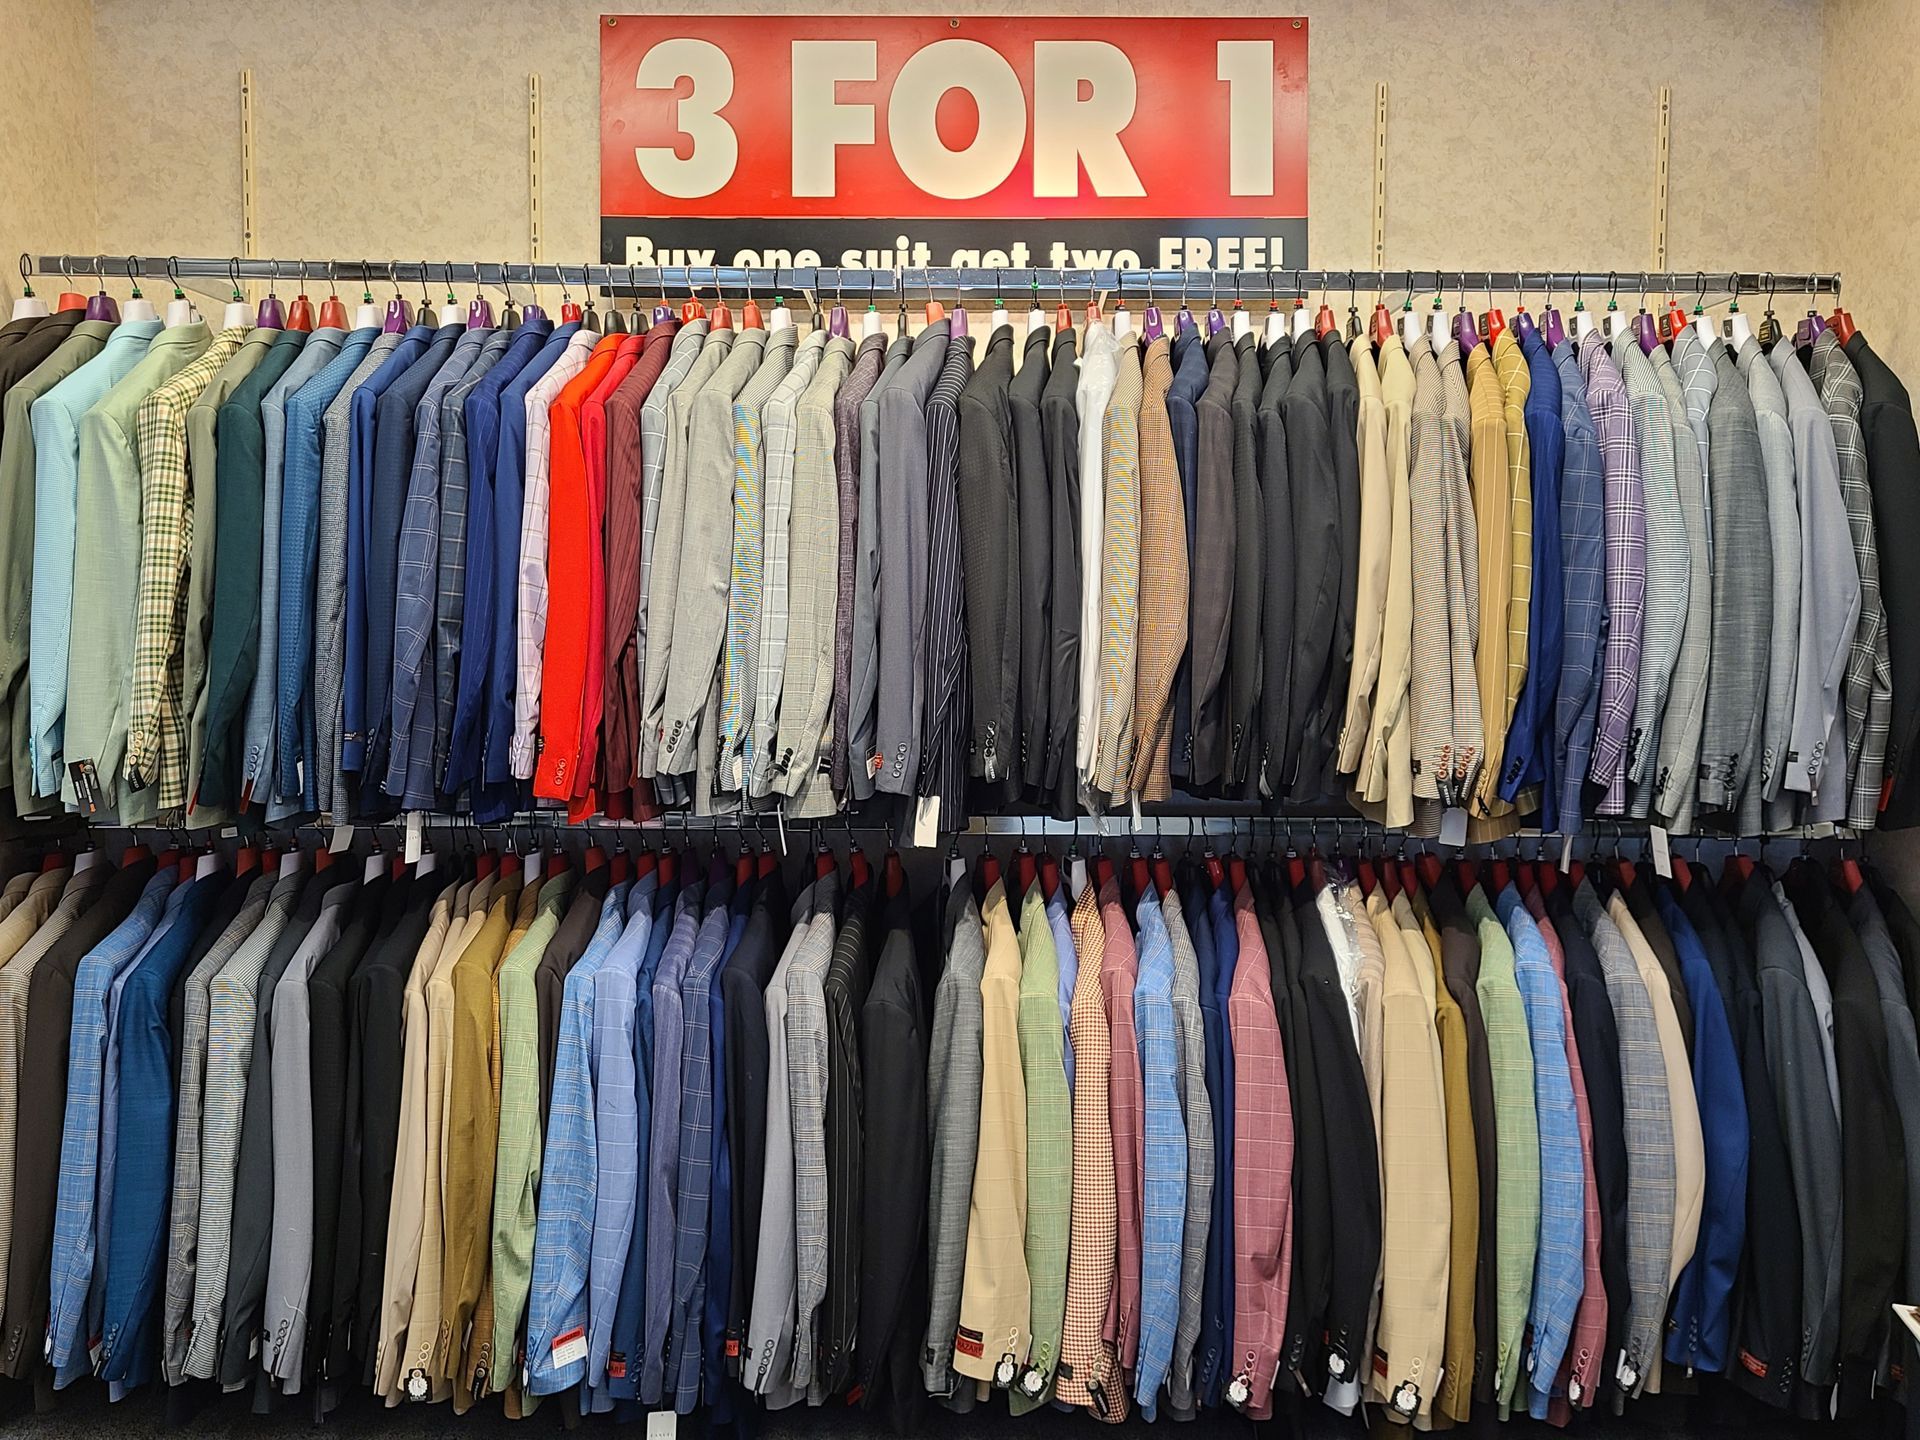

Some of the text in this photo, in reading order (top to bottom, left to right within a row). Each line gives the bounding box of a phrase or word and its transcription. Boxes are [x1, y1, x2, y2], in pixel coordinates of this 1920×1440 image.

[635, 38, 1275, 199] 3 FOR 1
[625, 236, 1284, 277] Buy one suit get two FREE!
